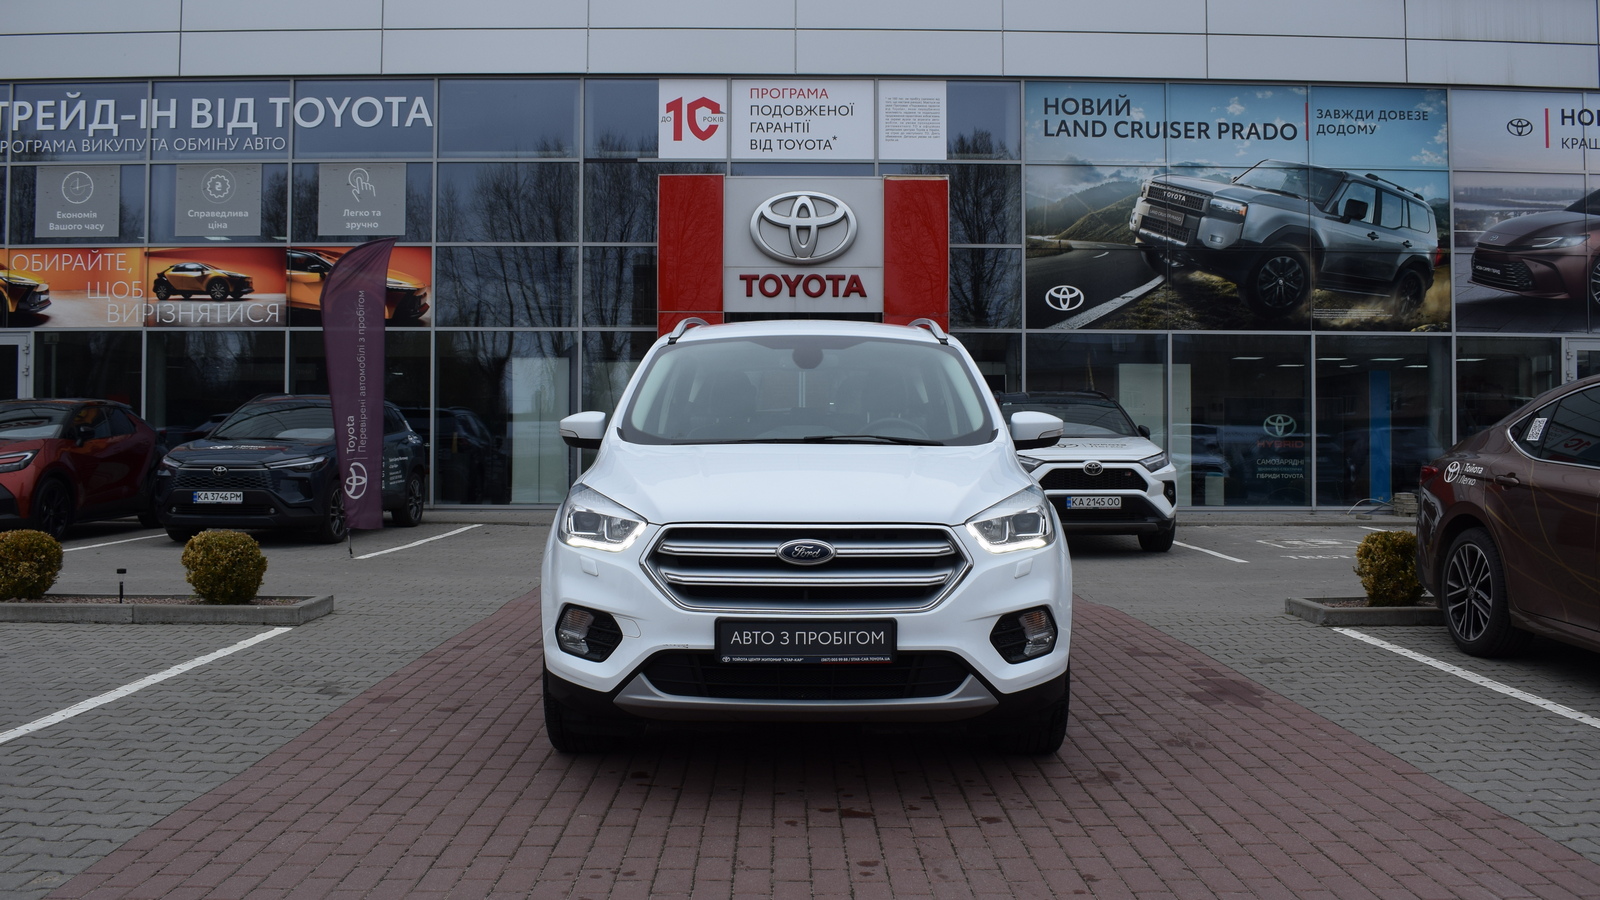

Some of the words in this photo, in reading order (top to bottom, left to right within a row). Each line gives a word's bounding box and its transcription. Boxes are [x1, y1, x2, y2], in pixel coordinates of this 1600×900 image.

[750, 87, 829, 99] ПРОГРАМА
[750, 102, 855, 118] ПОДОВЖЕНОЇ
[1043, 94, 1131, 117] НОВИЙ
[191, 97, 258, 136] ВІД
[268, 96, 433, 128] TOYOTA
[1316, 108, 1374, 121] ЗАВЖДИ
[1377, 110, 1429, 122] ДОВЕЗЕ
[750, 119, 811, 133] ГАРАНТІЇ
[1043, 119, 1108, 138] LAND
[1113, 120, 1211, 140] CRUISER
[1217, 122, 1298, 141] PRADO
[1316, 123, 1377, 136] ДОДОМУ
[81, 138, 146, 152] ВИКУПУ
[151, 137, 169, 151] ТА
[173, 136, 239, 151] ОБМІНУ
[243, 136, 286, 151] АВТО
[750, 138, 773, 152] ВІД
[1163, 191, 1186, 202] TOYOTA
[56, 211, 98, 219] Економія
[187, 209, 249, 219] Справедлива
[343, 209, 370, 217] Легко
[49, 222, 83, 232] Вашого
[84, 222, 105, 231] часу
[208, 221, 228, 230] ціна
[345, 221, 379, 230] зручно
[11, 249, 133, 274] ОБИРАЙТЕ,
[87, 280, 144, 302] ЩОБ
[739, 273, 868, 298] TOYOTA
[107, 303, 280, 323] ВИРІЗНЯТИСЯ
[356, 290, 367, 335] пробігом
[356, 344, 367, 397] автомобілі
[358, 399, 368, 453] Перевірені
[346, 415, 358, 454] Toyota
[1464, 462, 1484, 474] Тойота
[1460, 476, 1476, 486] Легко
[791, 544, 821, 558] Ford
[731, 631, 775, 645] АВТО
[795, 631, 885, 645] ПРОБІГОМ
